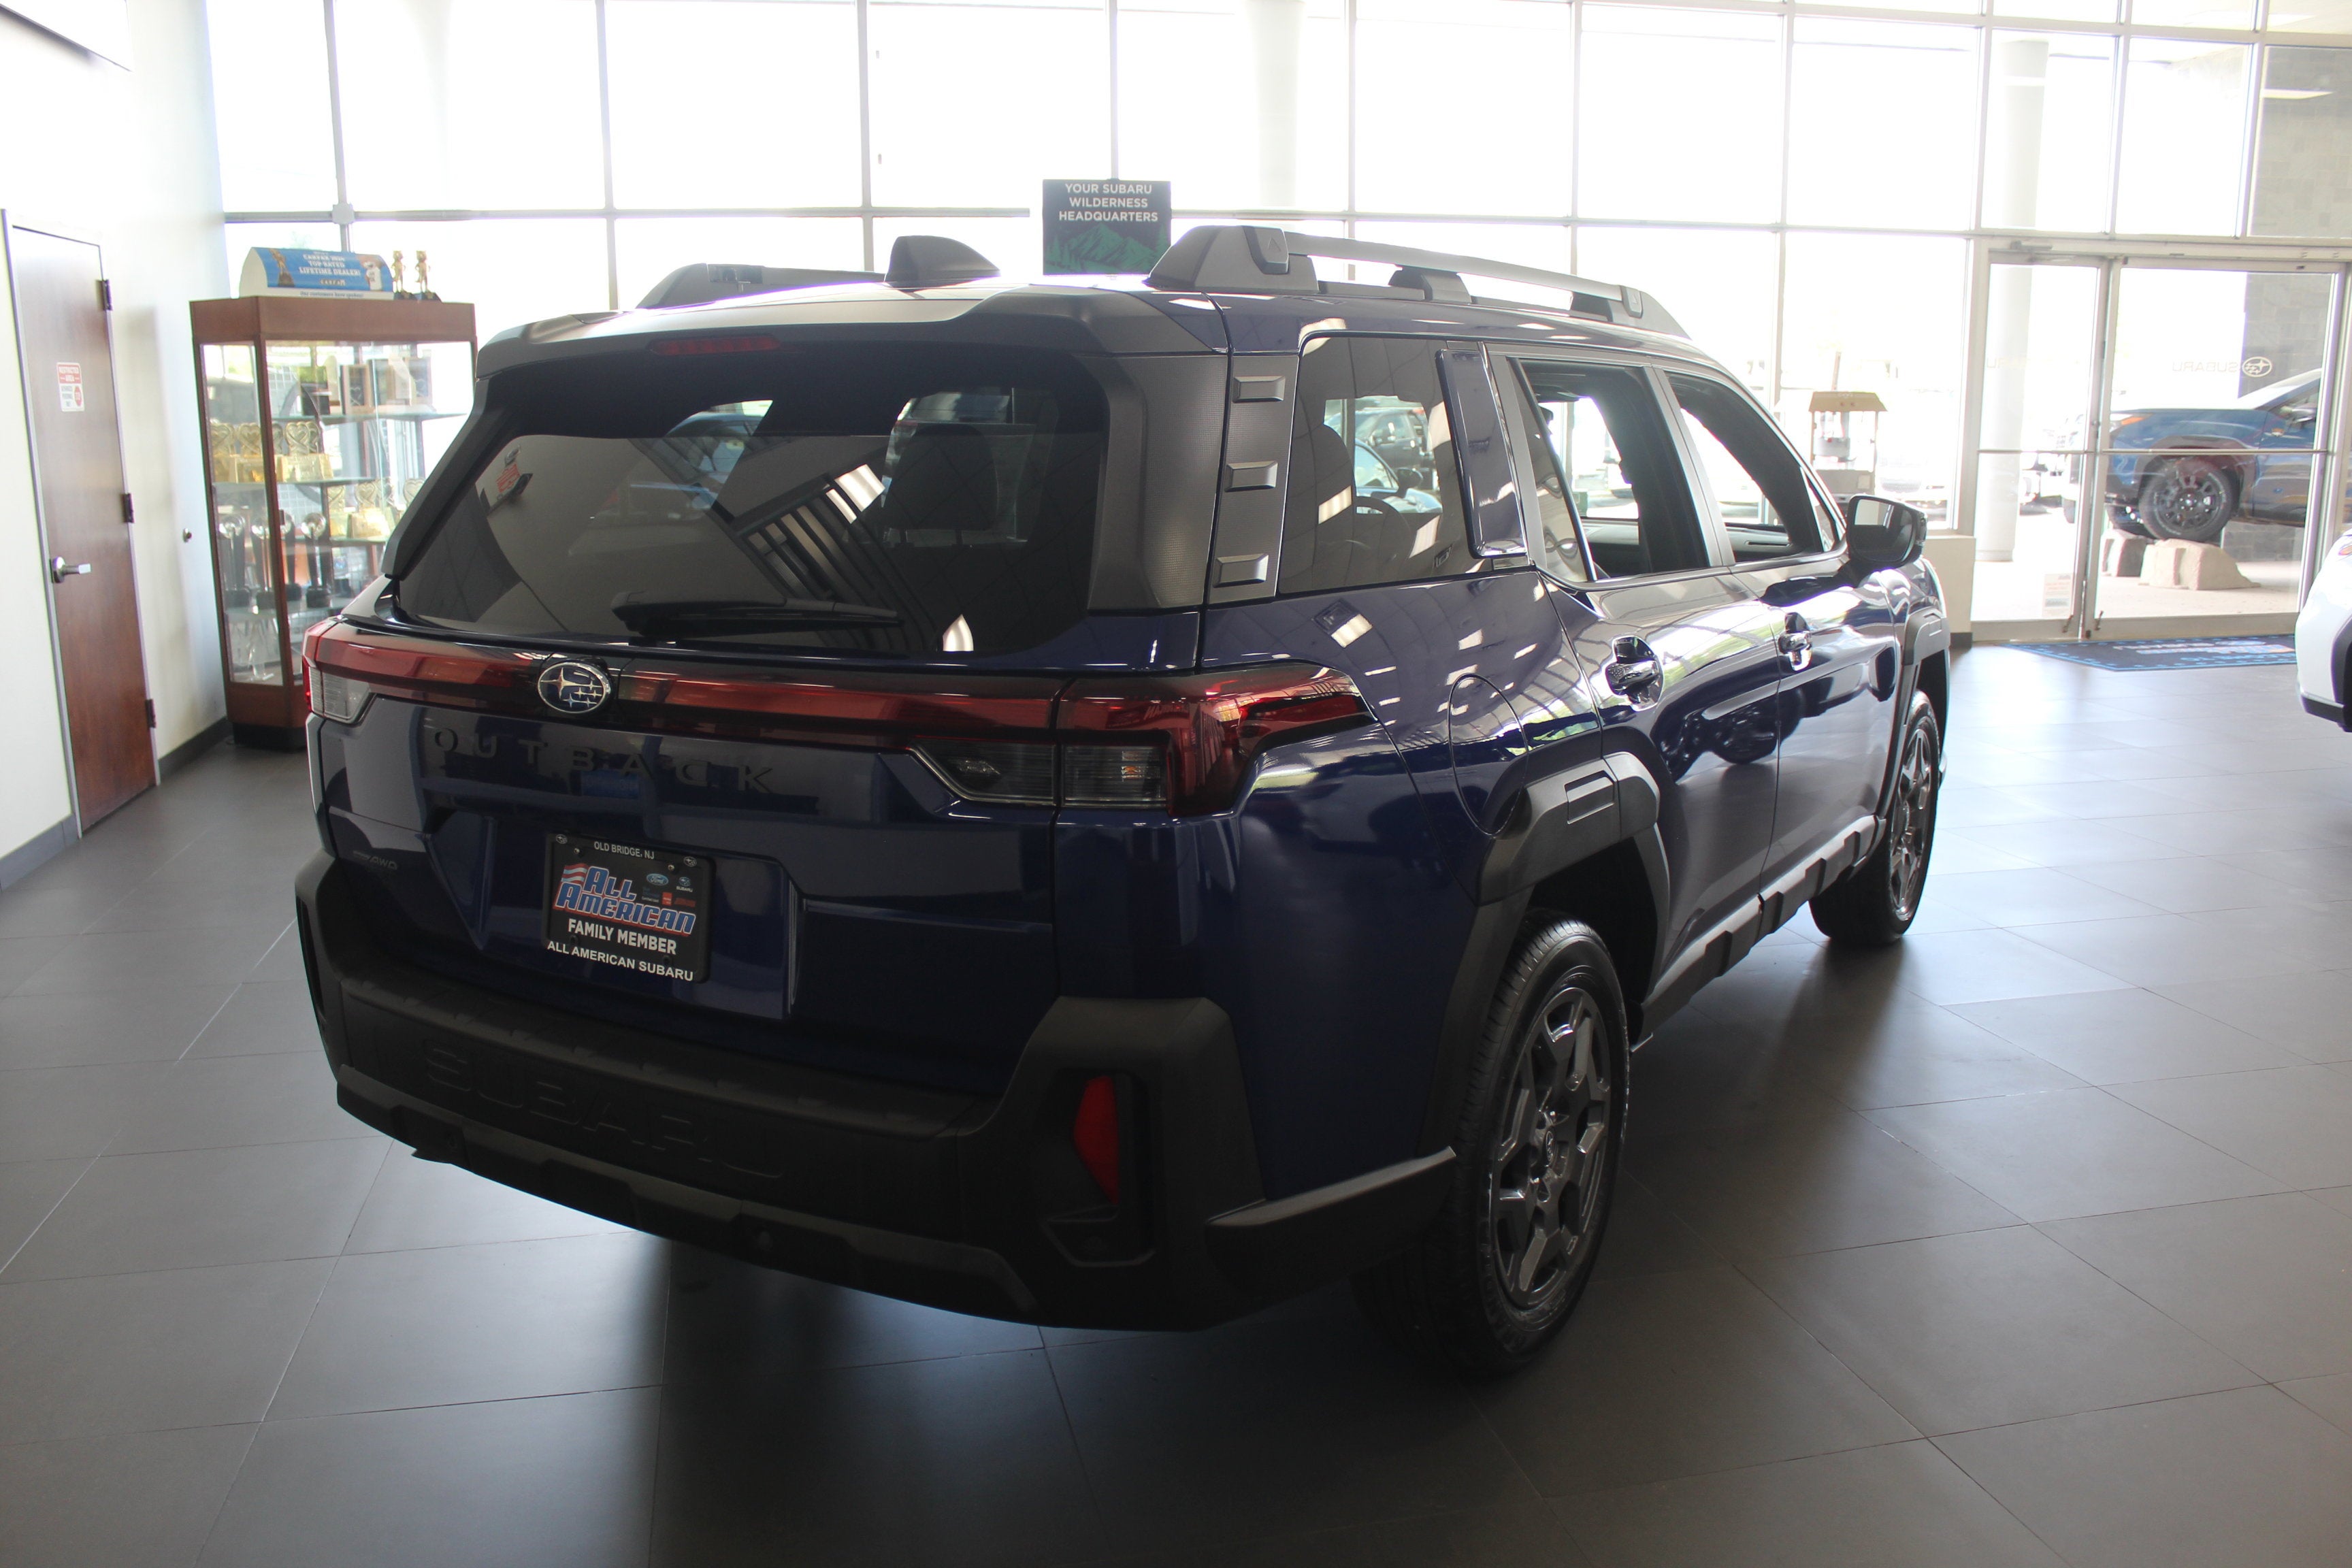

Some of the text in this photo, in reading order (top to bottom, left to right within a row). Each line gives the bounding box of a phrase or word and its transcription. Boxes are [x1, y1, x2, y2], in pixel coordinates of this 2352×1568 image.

[1065, 184, 1152, 194] YOUR SUBARU
[1069, 197, 1148, 208] WILDERNESS
[1059, 211, 1158, 222] HEADQUARTERS
[333, 268, 361, 276] DEALER!
[434, 727, 773, 794] OUTBACK
[594, 841, 609, 851] OLD
[644, 850, 655, 860] NJ
[370, 855, 397, 870] AWD
[568, 919, 676, 955] FAMILY MEMBER
[547, 941, 693, 981] ALL AMERICAN SUBARU
